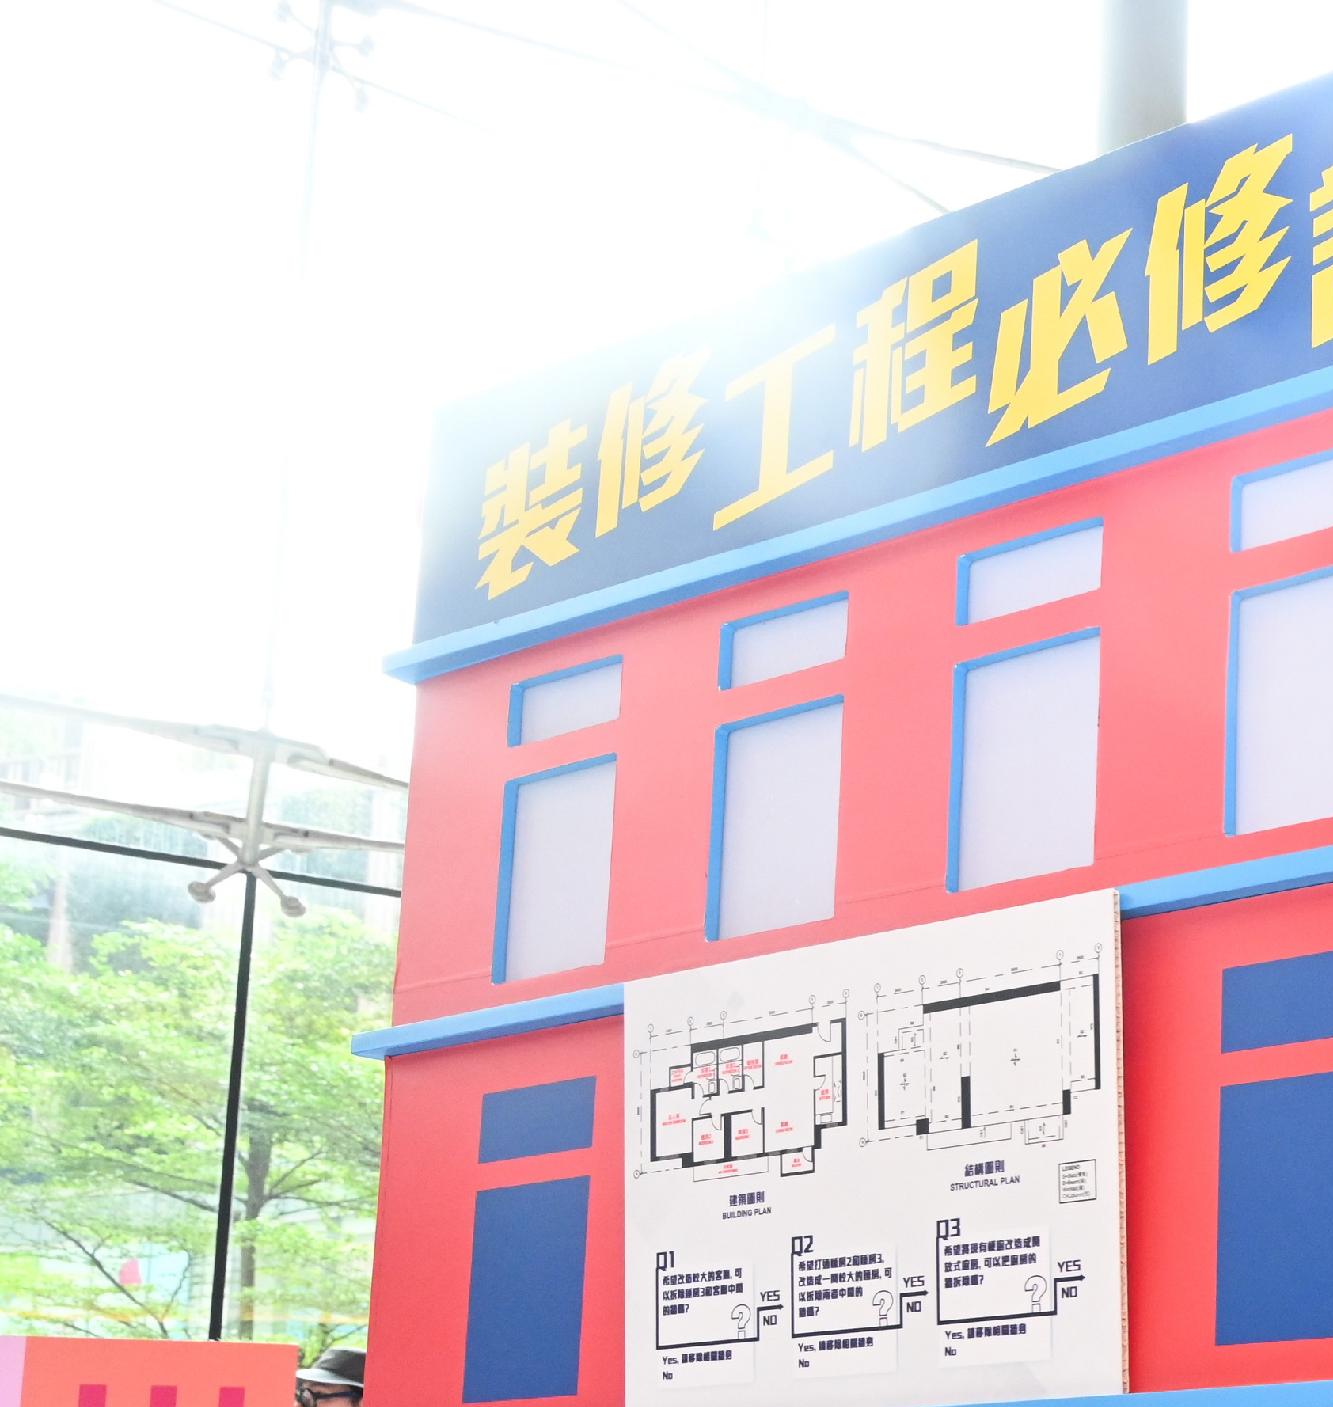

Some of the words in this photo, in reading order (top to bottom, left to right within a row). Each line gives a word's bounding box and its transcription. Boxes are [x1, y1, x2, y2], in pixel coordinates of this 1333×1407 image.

[950, 1178, 998, 1191] STRUCTURAL
[1001, 1175, 1021, 1185] PLAN
[722, 1208, 752, 1220] BUILDING
[753, 1206, 772, 1217] PLAN
[936, 1218, 960, 1240] Q3
[792, 1235, 814, 1256] Q2
[656, 1251, 675, 1271] Q1
[1058, 1260, 1081, 1272] YES
[903, 1275, 925, 1288] YES
[760, 1290, 780, 1302] YES
[1062, 1286, 1077, 1298] NO
[906, 1301, 922, 1313] NO
[763, 1315, 777, 1326] NO
[945, 1346, 956, 1356] No
[798, 1359, 810, 1368] No
[663, 1371, 673, 1380] No
